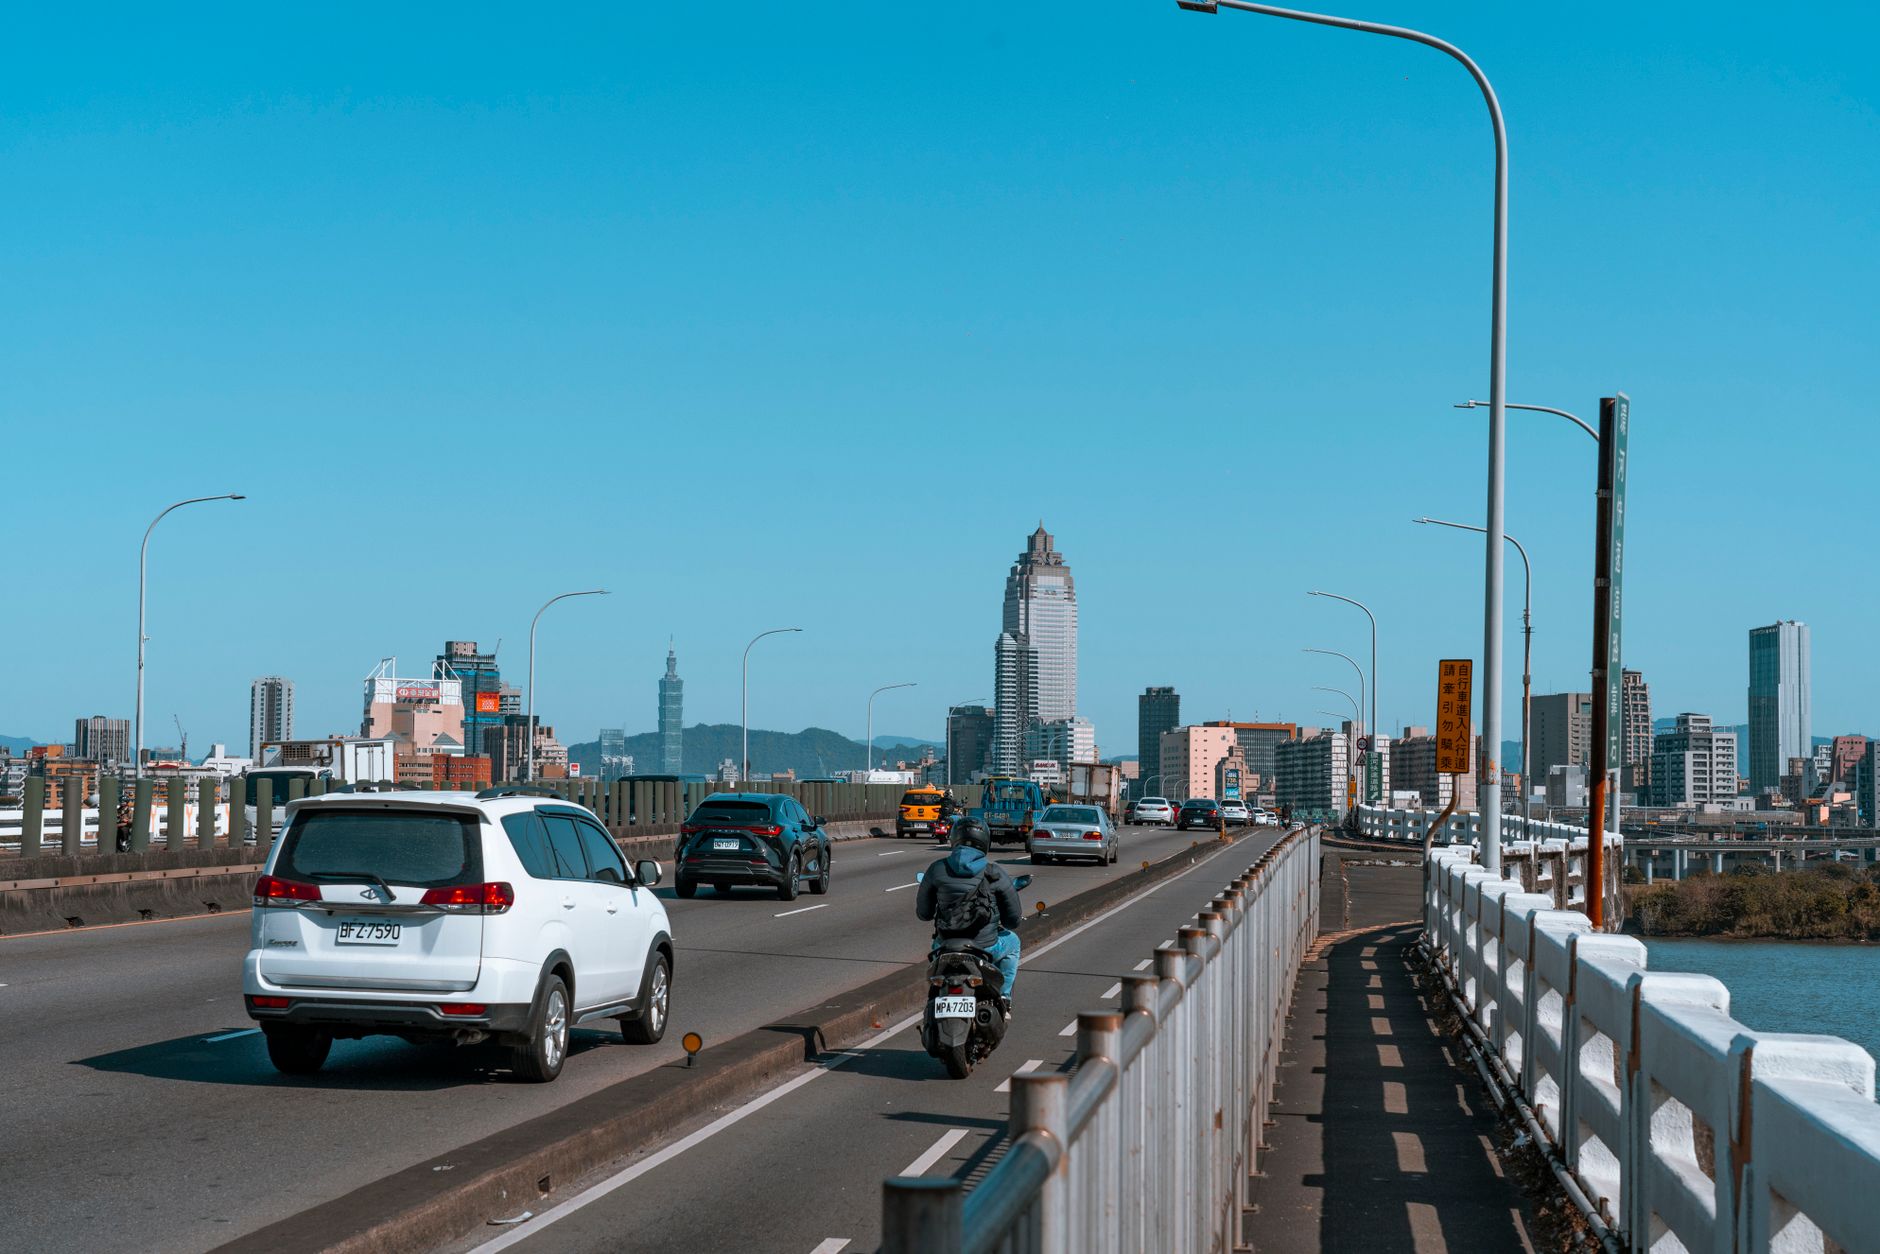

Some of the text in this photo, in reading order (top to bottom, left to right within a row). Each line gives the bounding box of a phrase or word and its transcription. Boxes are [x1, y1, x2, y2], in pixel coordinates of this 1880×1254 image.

[1440, 665, 1455, 769] 請牽引勿騎乘
[1454, 664, 1469, 770] 自行車進入人行道
[936, 1002, 974, 1013] MPA-7203
